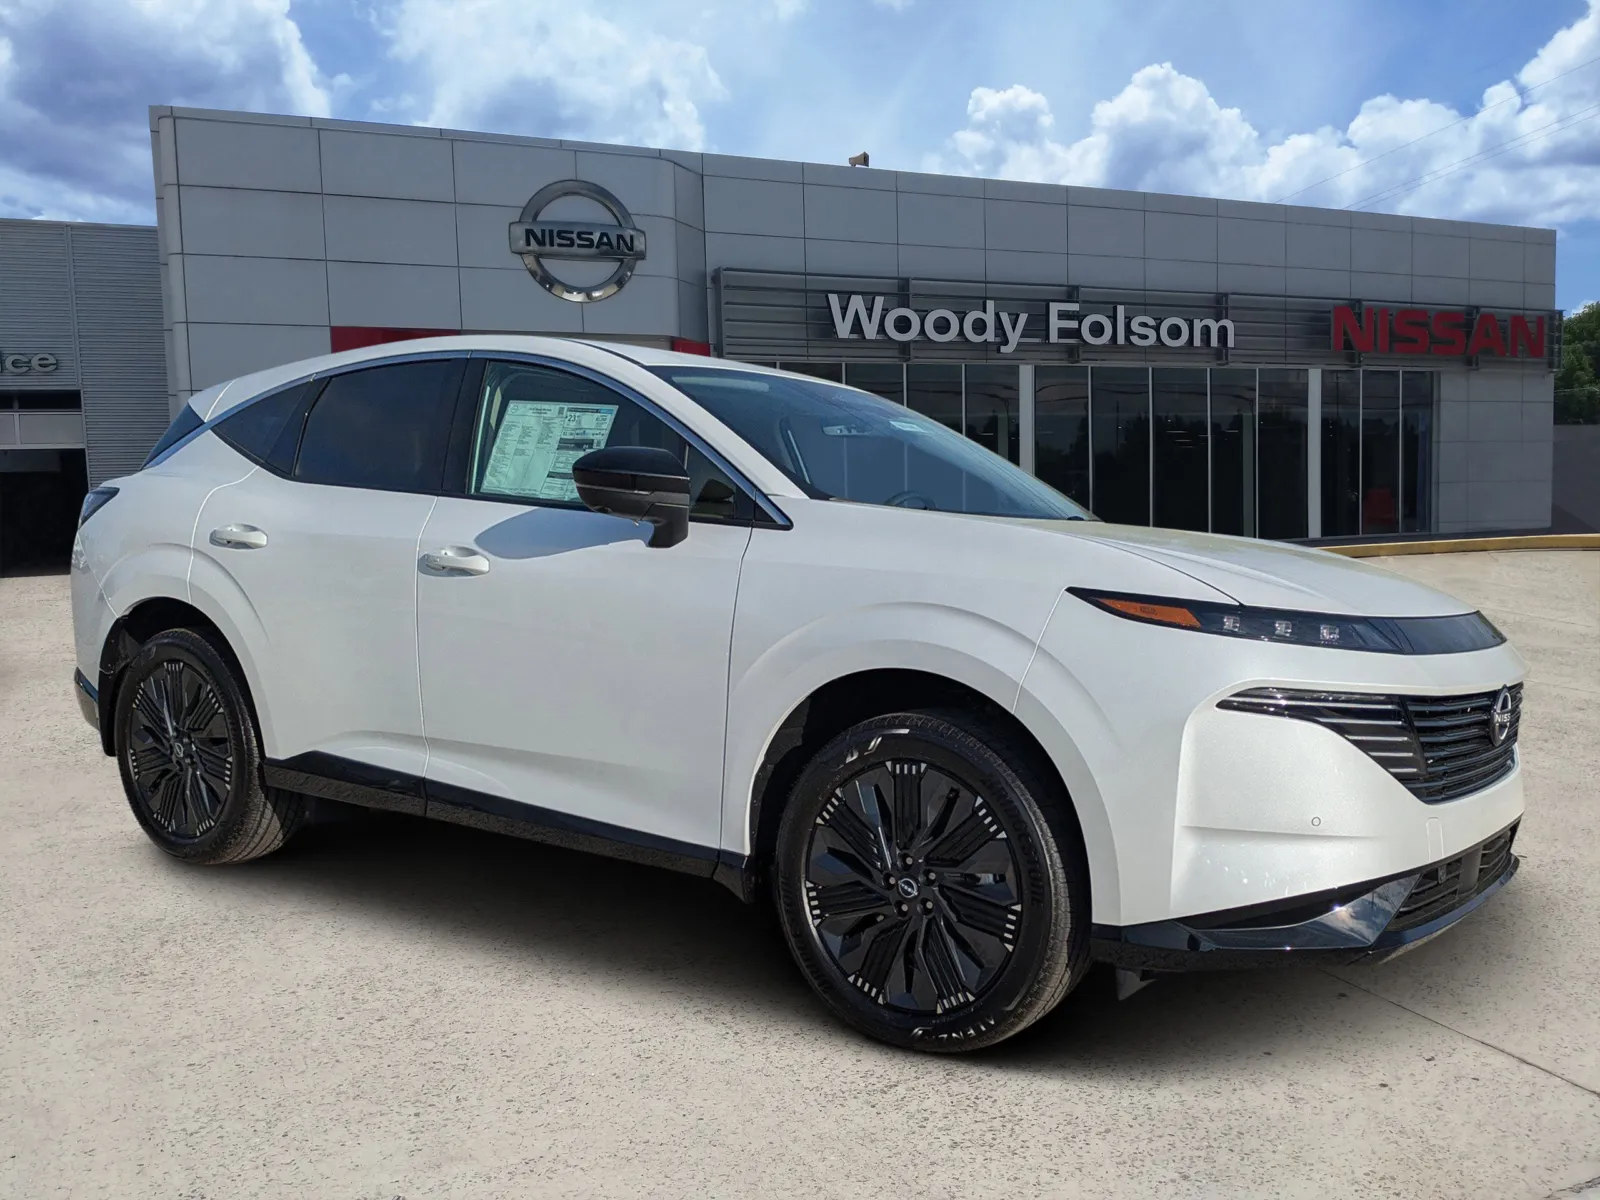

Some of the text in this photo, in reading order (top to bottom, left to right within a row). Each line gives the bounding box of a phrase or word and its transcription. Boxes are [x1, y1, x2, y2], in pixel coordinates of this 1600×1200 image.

[524, 228, 634, 252] NISSAN
[827, 293, 1545, 358] Woody Folsom NISSAN
[0, 353, 57, 373] ce
[1495, 712, 1511, 723] NISS
